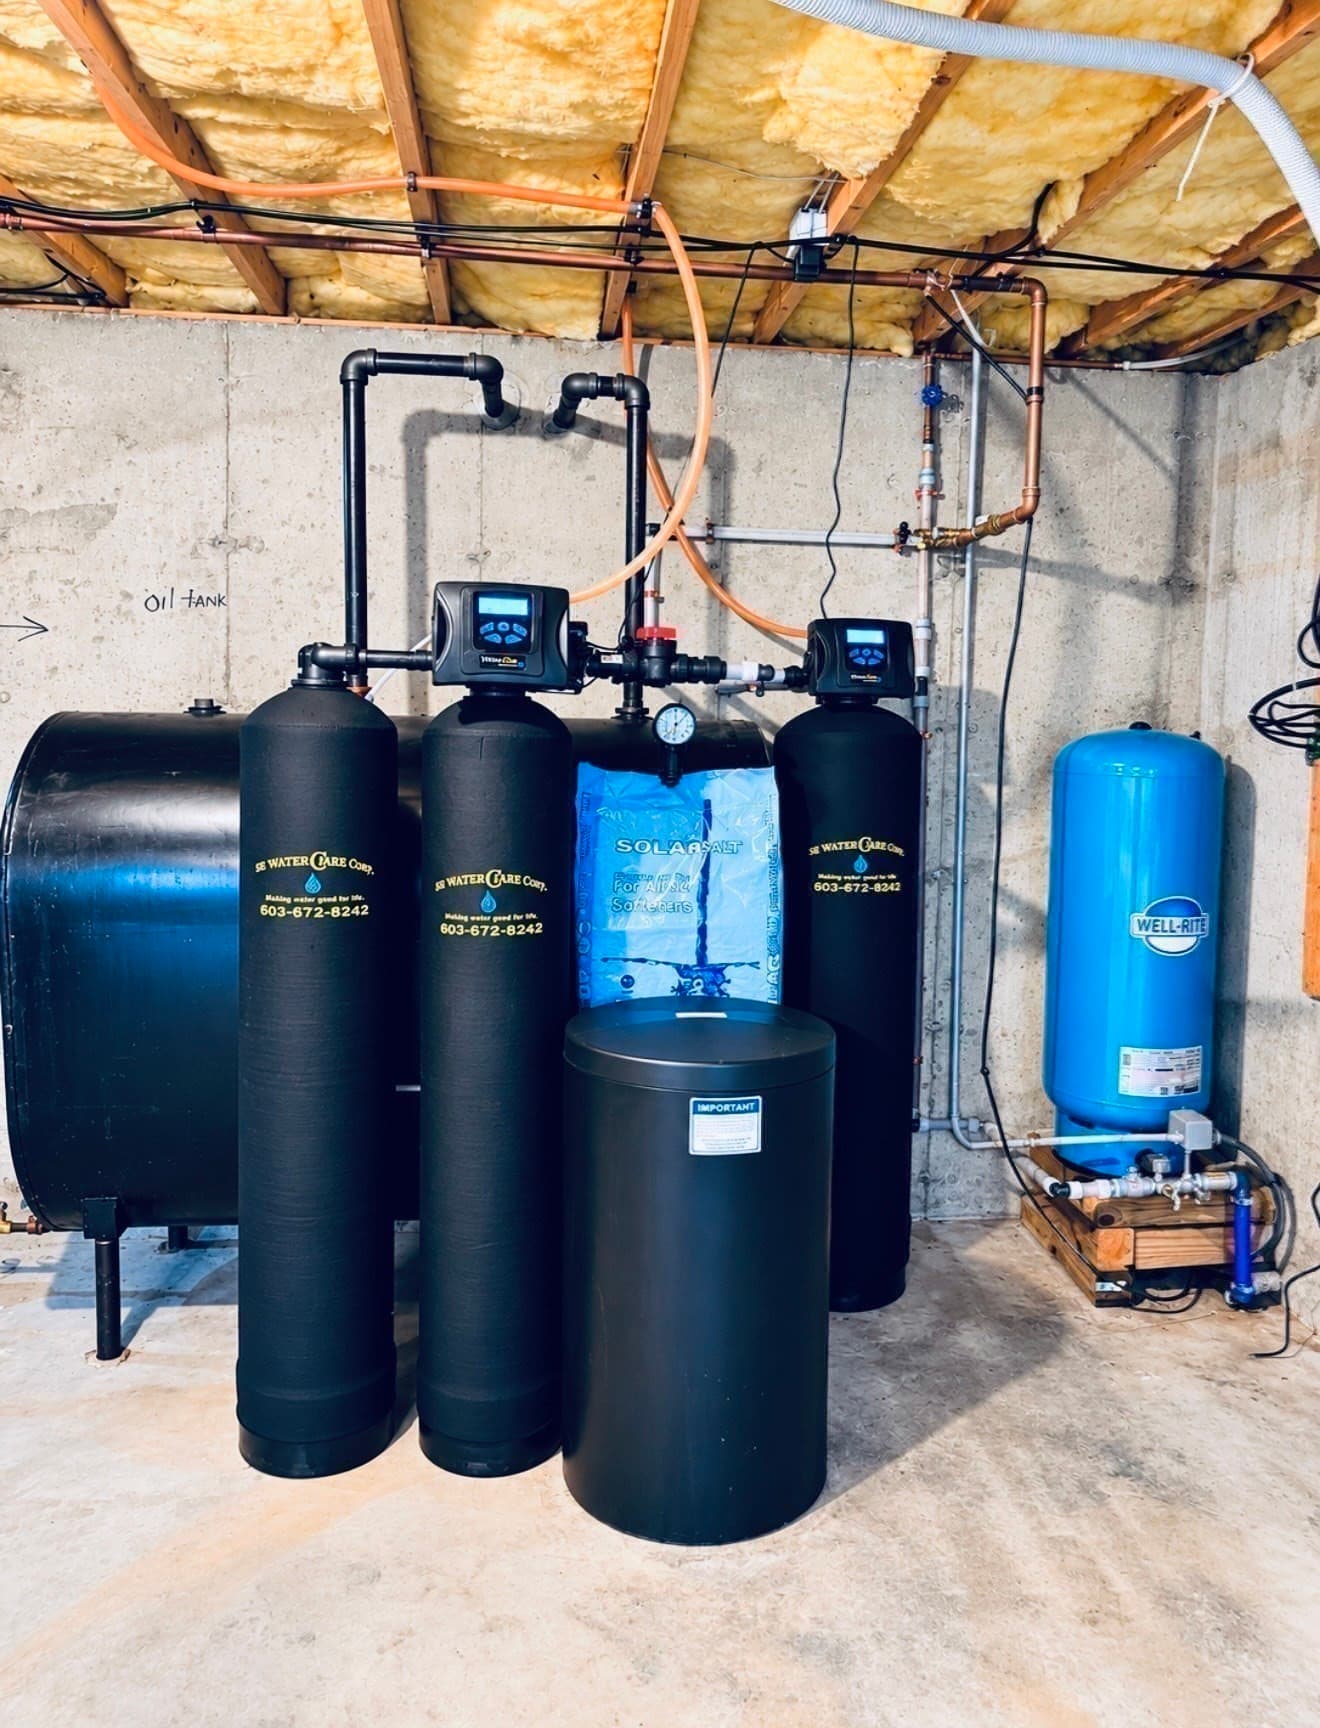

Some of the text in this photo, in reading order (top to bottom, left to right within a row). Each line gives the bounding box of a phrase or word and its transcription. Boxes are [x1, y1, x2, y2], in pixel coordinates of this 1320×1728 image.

[615, 838, 744, 856] SOLAR SALT
[613, 879, 640, 893] For
[814, 881, 901, 893] 603-672-8242
[260, 904, 369, 918] 603-672-8242
[440, 922, 543, 936] 603-672-8242
[1136, 917, 1206, 934] WELL-RITE
[697, 1102, 756, 1113] IMPORTANT
